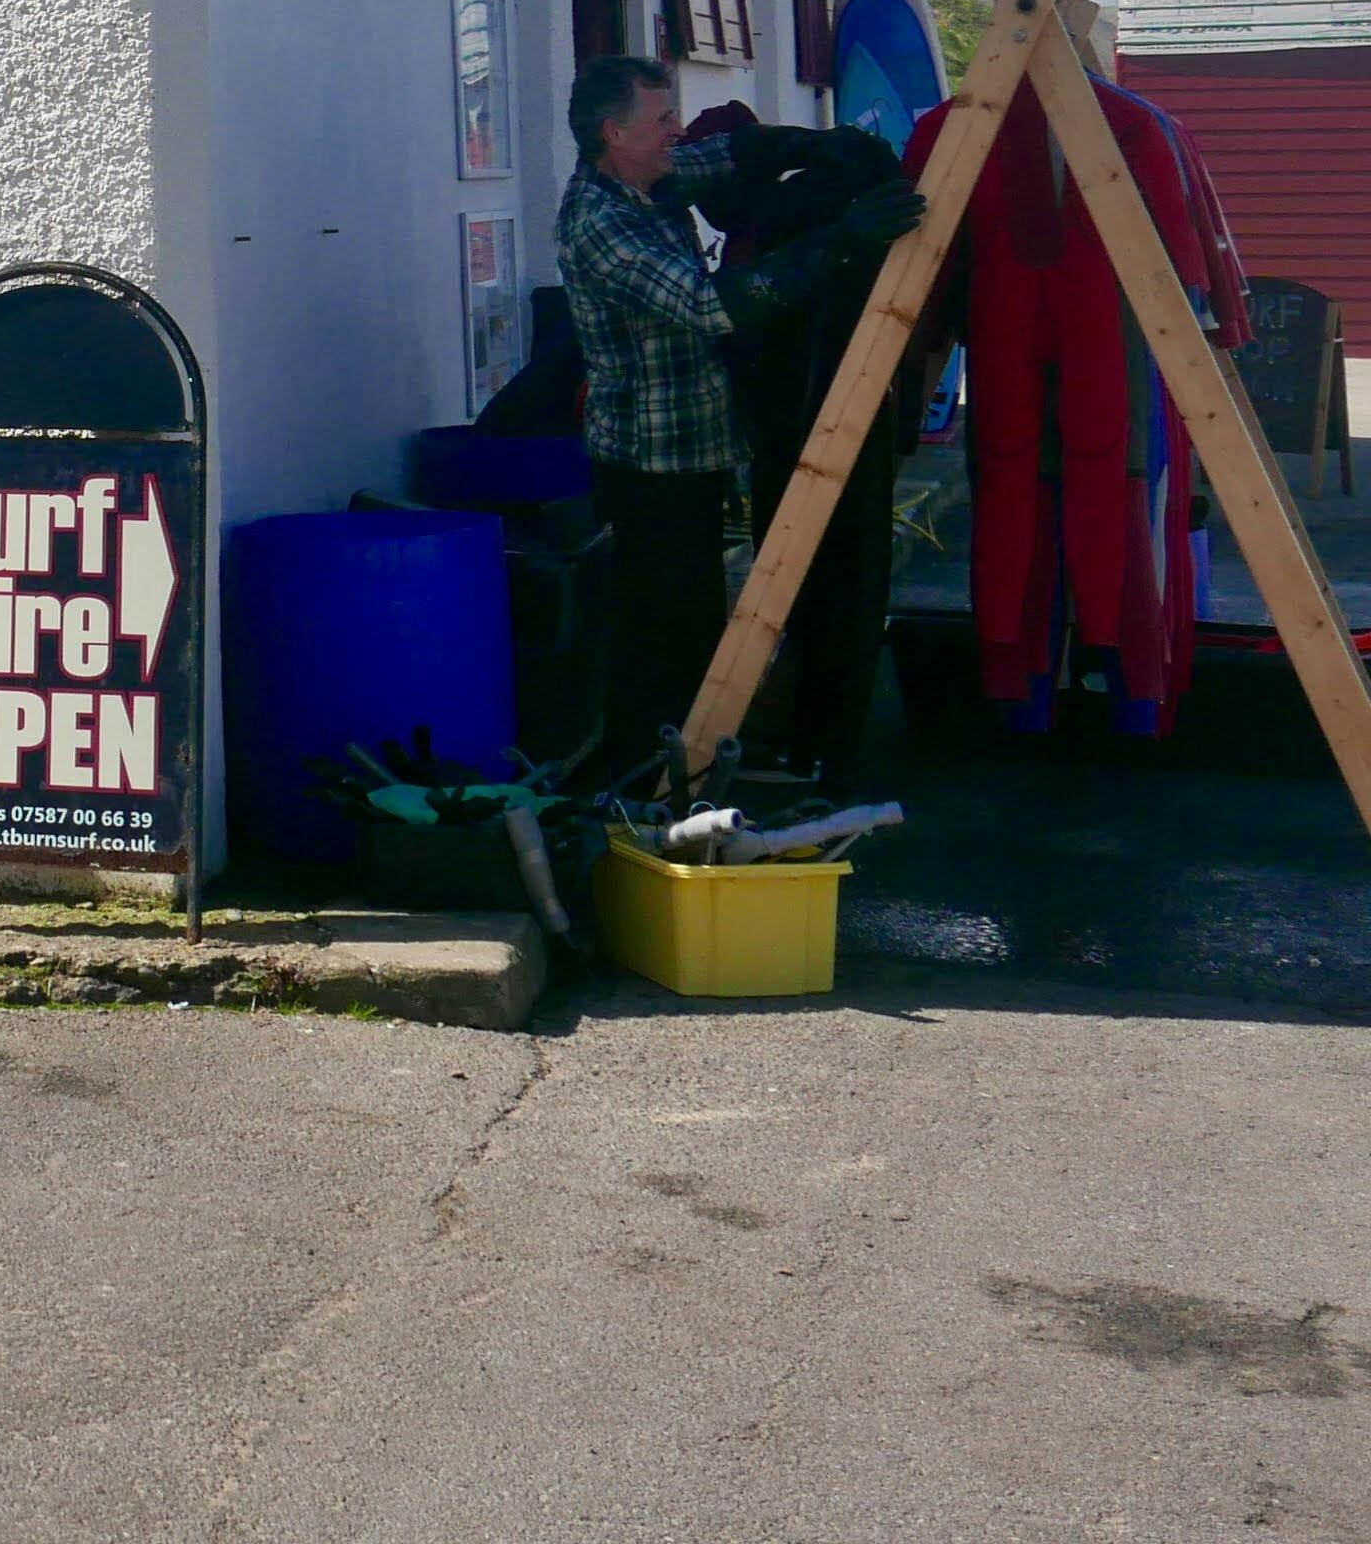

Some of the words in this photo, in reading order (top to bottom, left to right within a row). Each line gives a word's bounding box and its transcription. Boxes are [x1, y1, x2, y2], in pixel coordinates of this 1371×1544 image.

[11, 806, 68, 824] 07587
[72, 808, 97, 826] 00
[101, 810, 125, 827] 66
[130, 812, 153, 829] 39
